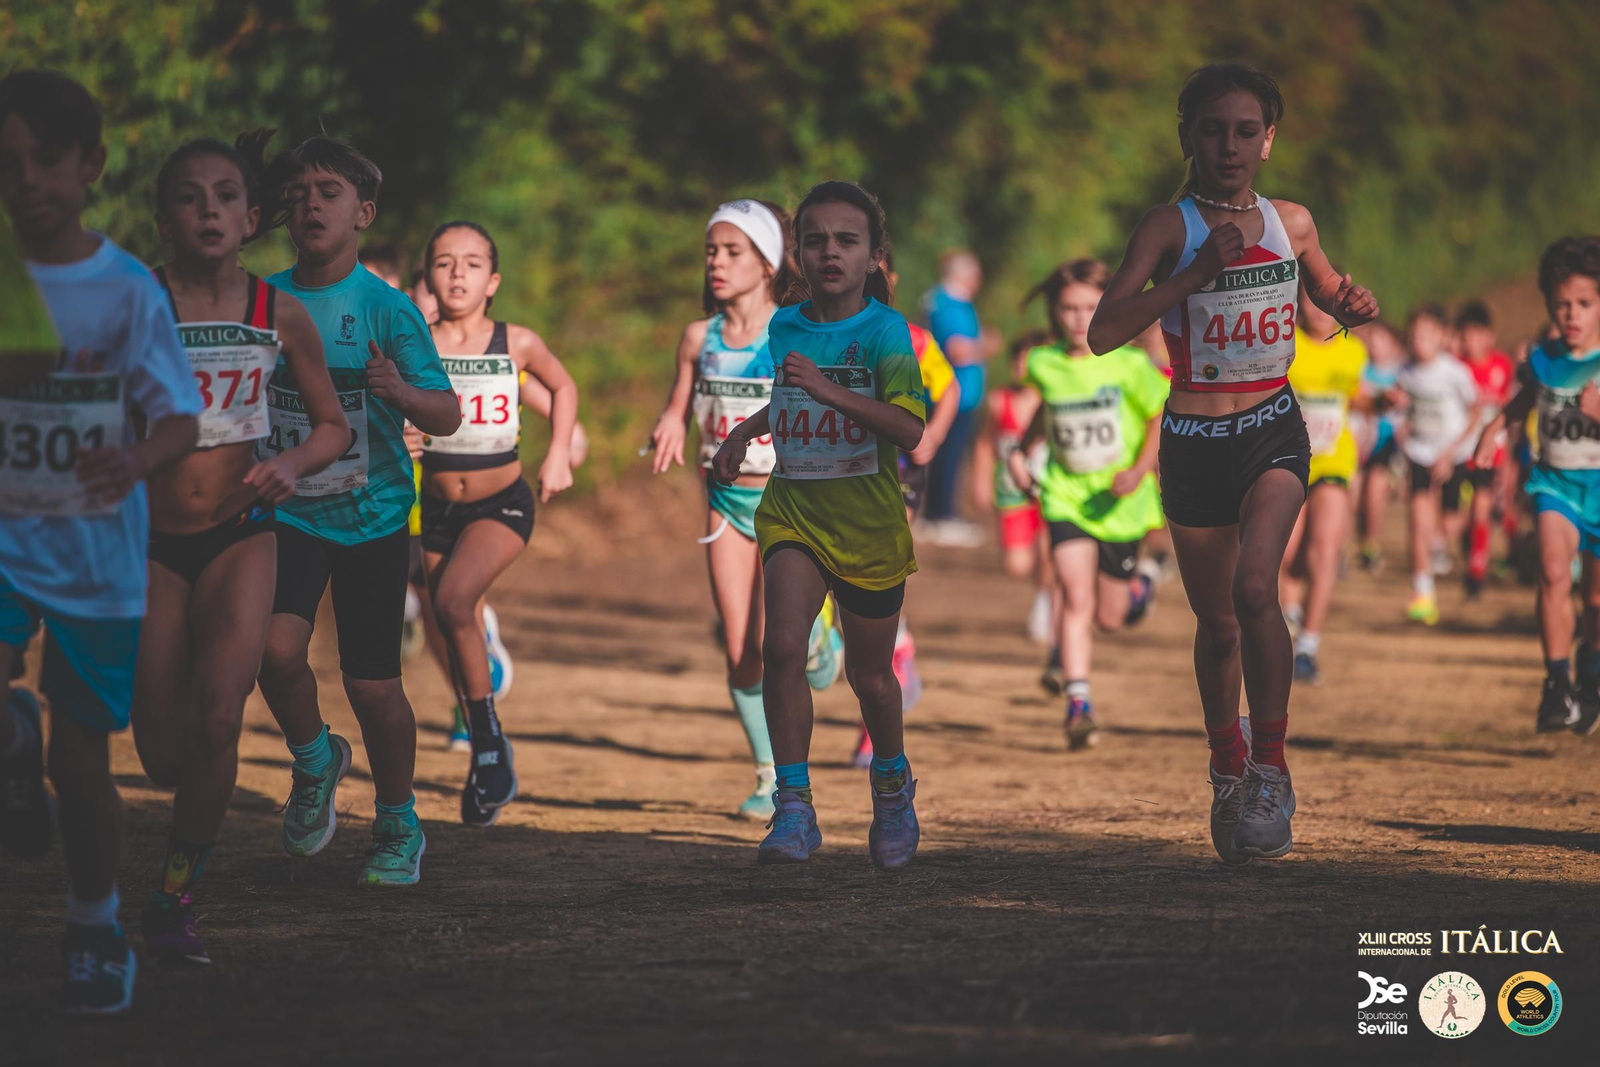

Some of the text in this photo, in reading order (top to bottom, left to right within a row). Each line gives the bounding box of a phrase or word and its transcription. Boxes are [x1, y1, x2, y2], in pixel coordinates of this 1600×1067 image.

[1225, 268, 1278, 287] ITÁLICA
[181, 327, 247, 344] ITÁLICA
[1202, 302, 1296, 351] 4463
[456, 394, 510, 425] 13
[1162, 415, 1232, 438] NIKE
[1236, 393, 1292, 435] PRO
[775, 408, 868, 446] 4446
